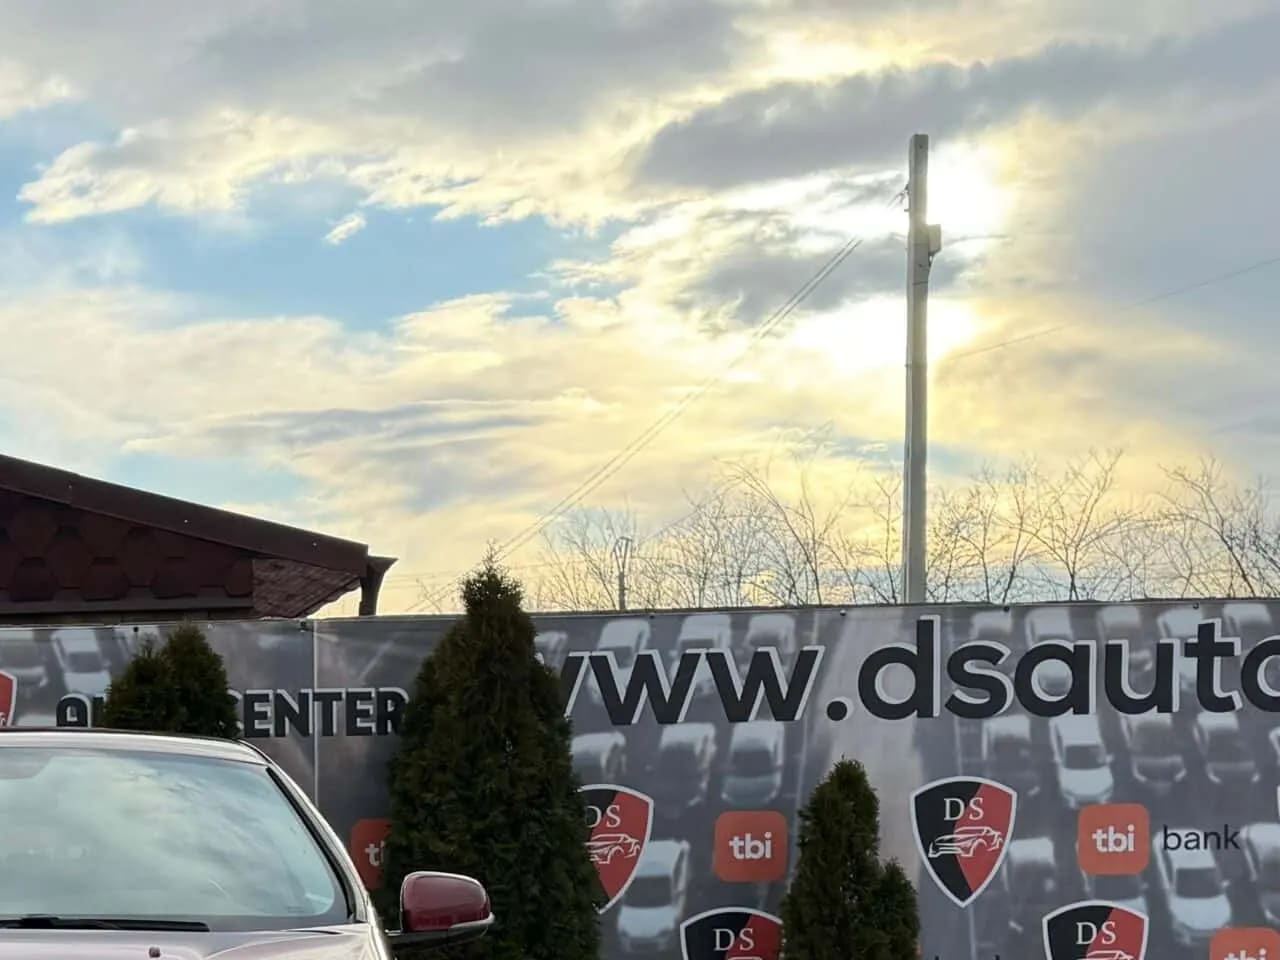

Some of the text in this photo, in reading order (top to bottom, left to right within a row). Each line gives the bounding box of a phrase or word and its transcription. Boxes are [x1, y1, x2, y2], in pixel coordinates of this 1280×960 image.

[560, 614, 1280, 725] ww.dsauto
[226, 687, 409, 738] ENTER
[943, 797, 985, 821] DS
[728, 832, 772, 860] tbi
[1091, 824, 1241, 853] tbi bank
[712, 928, 754, 951] DS
[1075, 921, 1117, 945] DS
